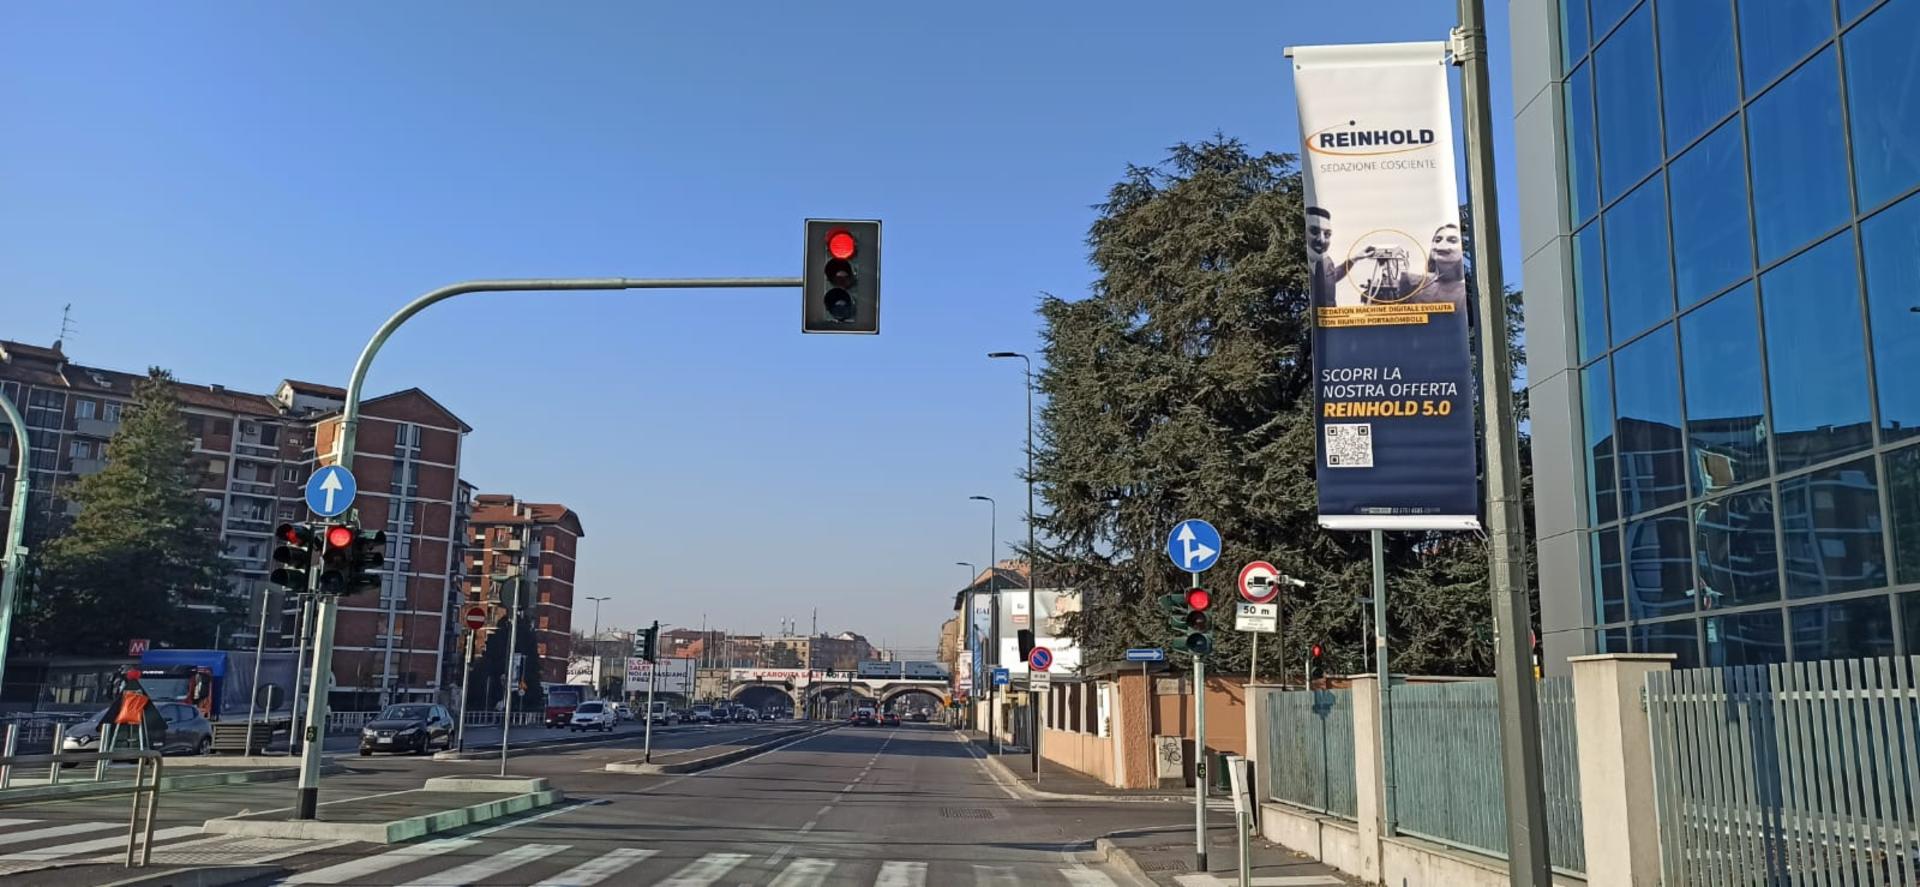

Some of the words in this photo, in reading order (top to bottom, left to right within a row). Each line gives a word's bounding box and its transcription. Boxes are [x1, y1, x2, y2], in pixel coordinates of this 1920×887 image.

[1320, 129, 1435, 148] REINHOLD
[1320, 160, 1377, 173] SEDAZIONE
[1381, 159, 1437, 171] COSCIENTE
[1320, 307, 1354, 316] SEDATION
[1356, 306, 1386, 314] MACHINE
[1389, 305, 1420, 313] DIGITALE
[1421, 304, 1452, 312] EVOLUTA
[1321, 368, 1378, 382] SCOPRI
[1383, 367, 1402, 381] LA
[1323, 383, 1385, 399] NOSTRA
[1390, 382, 1458, 397] OFFERTA
[1324, 401, 1418, 418] REINHOLD
[1422, 400, 1452, 416] 5.0
[1243, 605, 1256, 614] 50
